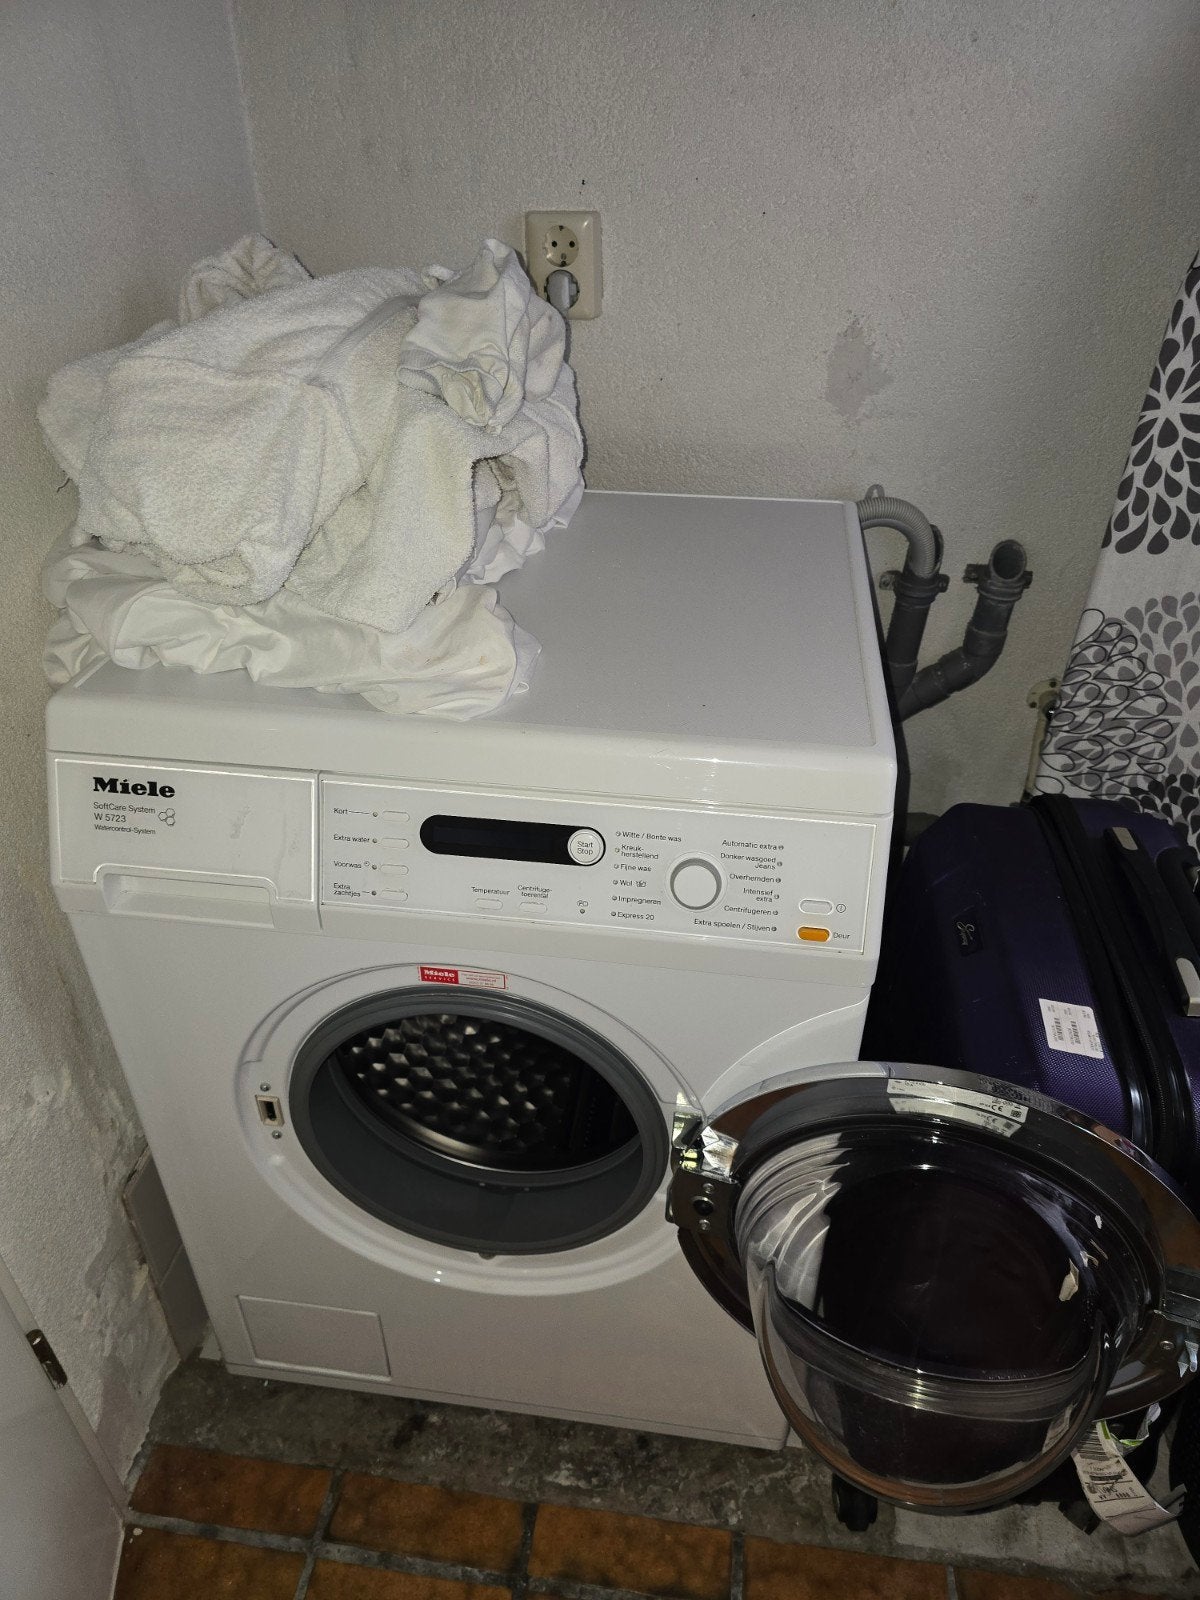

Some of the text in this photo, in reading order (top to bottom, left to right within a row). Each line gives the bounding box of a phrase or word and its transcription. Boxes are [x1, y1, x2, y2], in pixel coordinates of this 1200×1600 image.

[93, 777, 175, 798] Miele
[93, 802, 156, 814] SoftCare System
[94, 813, 126, 823] W 5723
[94, 824, 156, 835] Watercontrol-System
[333, 834, 351, 842] Extra
[622, 831, 640, 839] Witte
[722, 840, 758, 849] Automatic
[577, 848, 593, 856] Stop
[720, 852, 777, 865] Donker wasgoed
[333, 861, 362, 869] Voorwas
[729, 873, 775, 883] Overhemden
[619, 879, 633, 887] Wol
[333, 889, 361, 898] zachtjes
[471, 887, 510, 896] Temperatuur
[521, 891, 549, 899] toerental
[743, 888, 774, 897] Intensief
[756, 895, 773, 903] extra
[723, 905, 772, 916] Centrifugeren
[617, 912, 644, 920] Express
[694, 919, 712, 927] Extra
[713, 921, 741, 930] spoelen
[747, 924, 771, 933] Stijven
[833, 932, 850, 940] Deur
[423, 969, 456, 978] Miele
